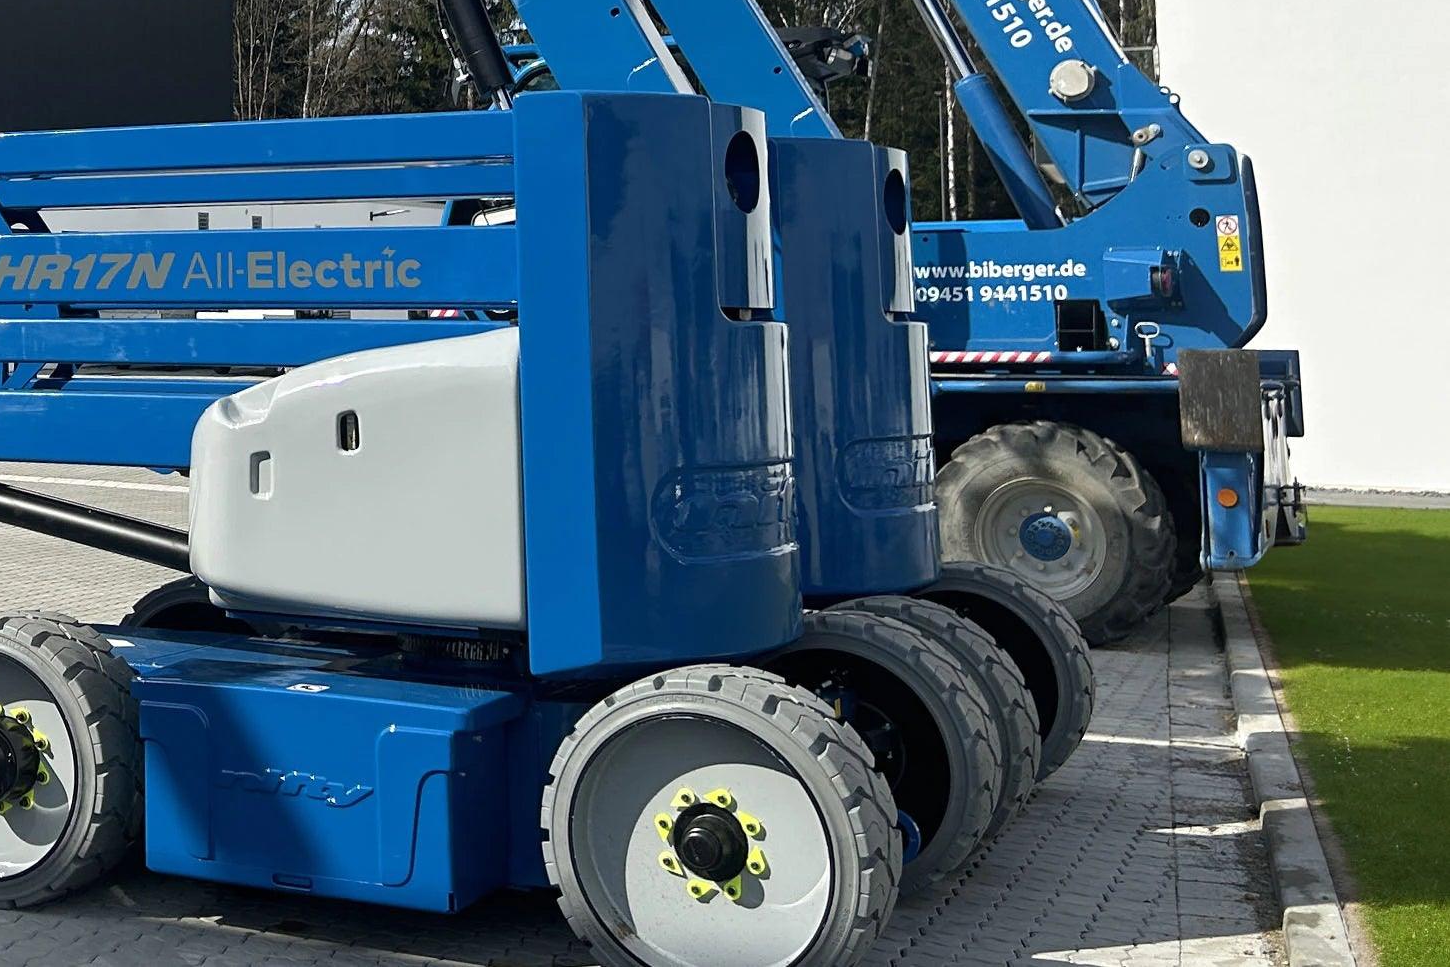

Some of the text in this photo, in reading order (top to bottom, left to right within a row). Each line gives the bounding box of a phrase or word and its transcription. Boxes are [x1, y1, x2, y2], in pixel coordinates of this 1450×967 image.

[914, 259, 1087, 282] www.biberger.de
[916, 284, 1068, 302] 09451 9441510
